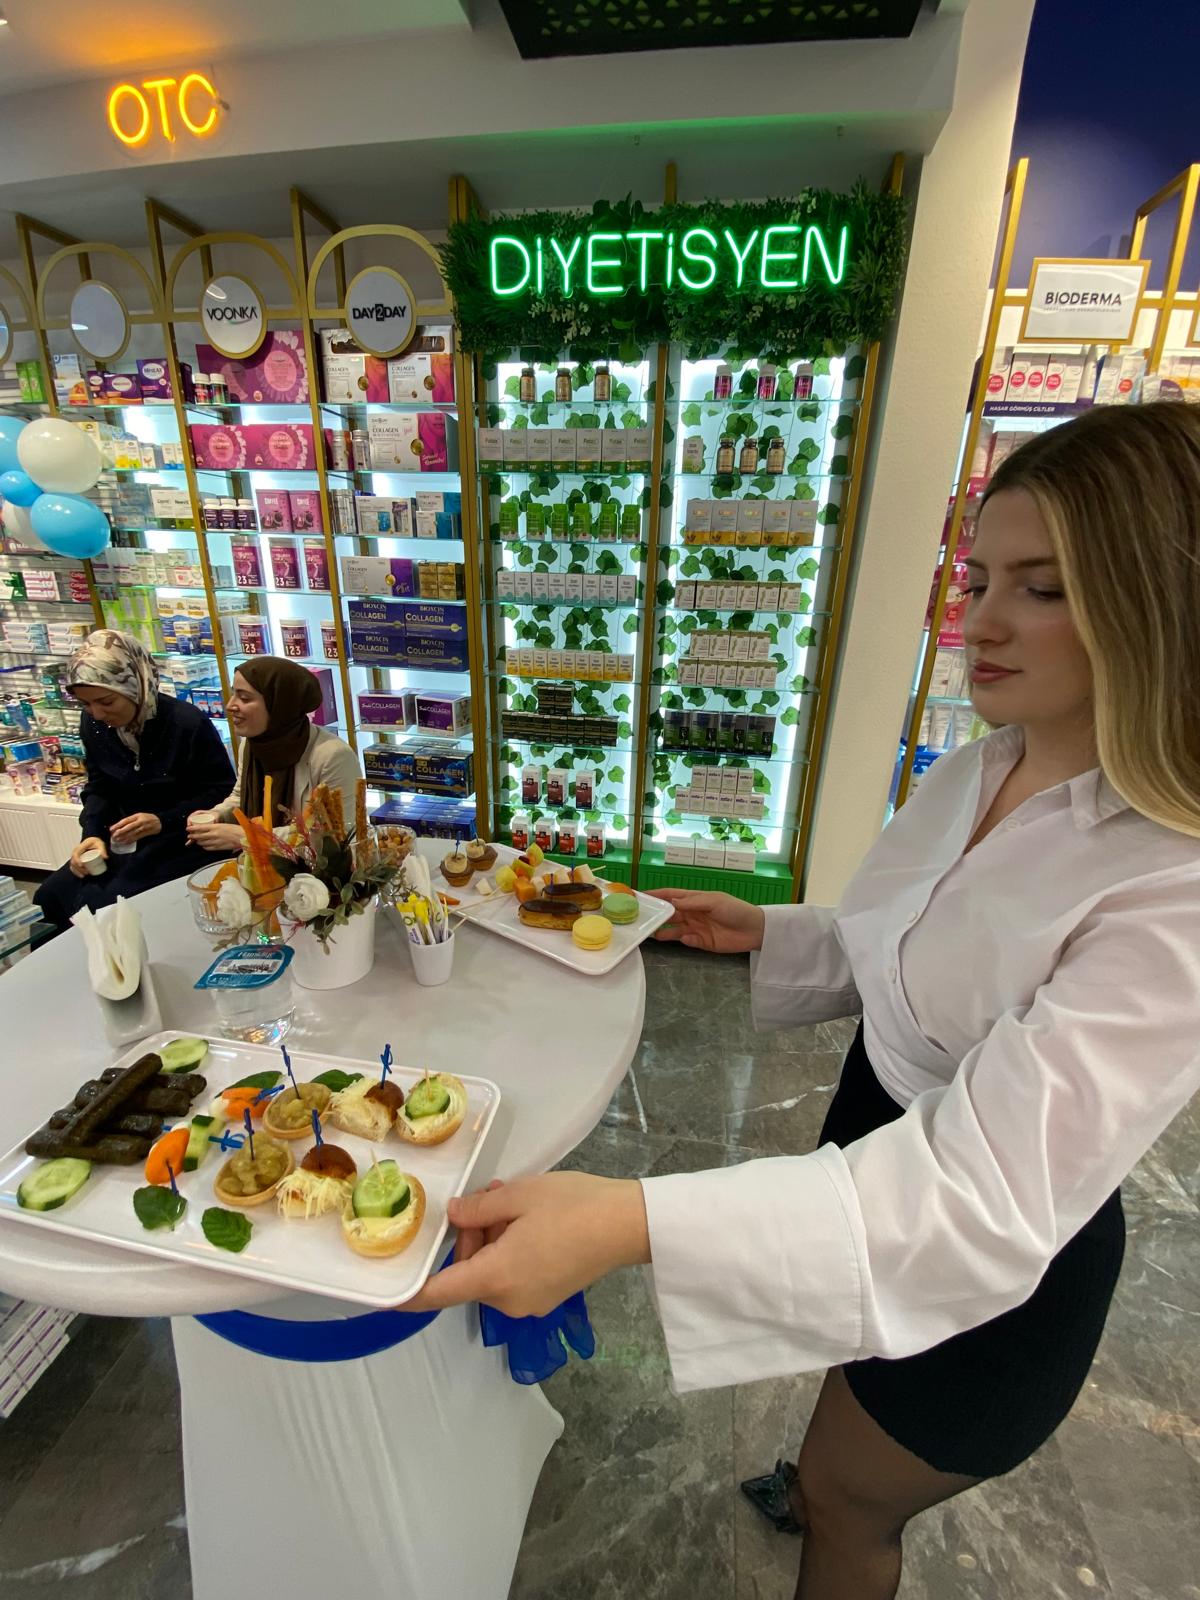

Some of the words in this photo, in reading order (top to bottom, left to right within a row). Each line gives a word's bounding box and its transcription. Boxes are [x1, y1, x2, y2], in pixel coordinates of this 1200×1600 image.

[109, 73, 217, 143] OTC
[1045, 292, 1122, 306] BIODERMA
[206, 306, 257, 320] VOONKA
[352, 304, 407, 321] DAY2DAY
[350, 610, 387, 620] COLLAGEN
[405, 612, 444, 623] COLLAGEN
[352, 642, 389, 653] COLLAGEN
[406, 646, 445, 657] COLLAGEN
[366, 761, 413, 772] COLLAGEN
[416, 766, 464, 778] COLLAGEN
